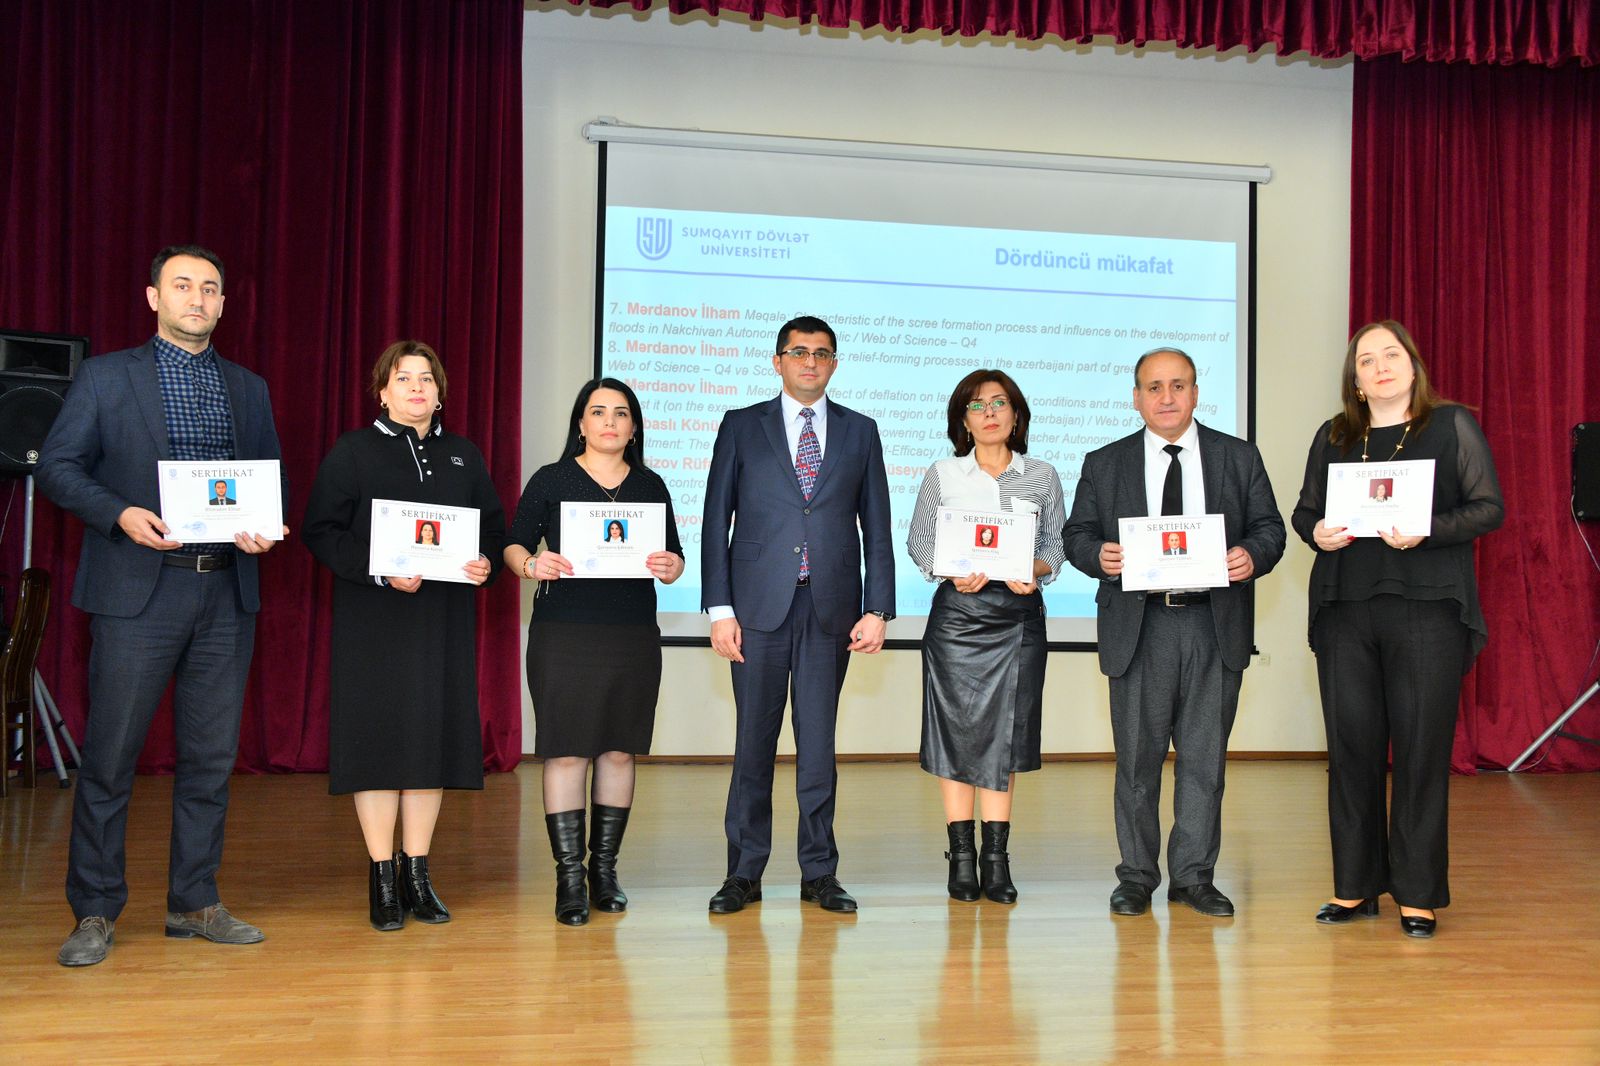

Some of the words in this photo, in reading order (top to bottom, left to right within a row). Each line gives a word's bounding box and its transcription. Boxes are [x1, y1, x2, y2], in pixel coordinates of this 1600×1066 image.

[681, 226, 752, 241] SUMQAYIT
[757, 230, 810, 244] DÖVLƏT
[701, 243, 791, 260] UNİVERSİTETİ
[995, 247, 1090, 270] Dördüncü
[1097, 254, 1174, 275] mükafat
[609, 302, 622, 316] 7.
[627, 302, 697, 318] Mərdanov
[701, 303, 740, 320] İlham
[873, 316, 886, 327] of
[888, 316, 905, 328] the
[908, 319, 938, 329] scree
[941, 318, 992, 332] formation
[995, 323, 1038, 335] process
[1040, 324, 1061, 335] and
[1063, 325, 1111, 338] influence
[1114, 329, 1127, 338] on
[1130, 327, 1147, 339] the
[1149, 328, 1216, 343] development
[1218, 331, 1231, 342] of
[608, 322, 645, 334] floods
[648, 324, 659, 334] in
[662, 323, 723, 337] Nakchivan
[725, 326, 777, 340] Autonom
[861, 332, 886, 344] Web
[889, 334, 902, 345] of
[904, 336, 946, 347] Science
[960, 337, 977, 348] Q4
[607, 340, 621, 353] 8.
[626, 339, 696, 355] Mərdanov
[701, 340, 739, 357] İlham
[743, 347, 776, 361] Məqa
[848, 351, 920, 367] relief-forming
[923, 355, 980, 368] processes
[982, 357, 992, 367] in
[996, 357, 1013, 368] the
[1015, 359, 1074, 373] azerbaijani
[1076, 362, 1098, 374] part
[1100, 362, 1112, 373] of
[1113, 365, 1136, 376] grea
[608, 359, 635, 372] Web
[638, 360, 651, 372] of
[654, 362, 700, 373] Science
[714, 364, 731, 376] Q4
[700, 378, 738, 395] İlham
[827, 388, 852, 400] ffect
[855, 389, 868, 400] of
[869, 389, 916, 403] deflation
[919, 392, 933, 402] on
[1032, 396, 1087, 409] conditions
[1089, 398, 1110, 409] and
[663, 400, 682, 413] (on
[686, 400, 704, 411] the
[888, 409, 924, 422] region
[926, 409, 939, 421] of
[1031, 413, 1084, 427] zerbaijan)
[1095, 415, 1118, 427] Web
[1121, 416, 1134, 428] of
[681, 417, 719, 433] Könü
[1029, 432, 1059, 444] acher
[688, 438, 710, 450] The
[1044, 449, 1060, 461] Q4
[191, 468, 254, 478] SERTİFİKAT
[668, 477, 705, 490] contro
[680, 493, 698, 505] Q4
[401, 508, 458, 522] SERTİFİKAT
[589, 509, 645, 519] SERTİFİKAT
[1147, 522, 1202, 532] SERTİFİKAT
